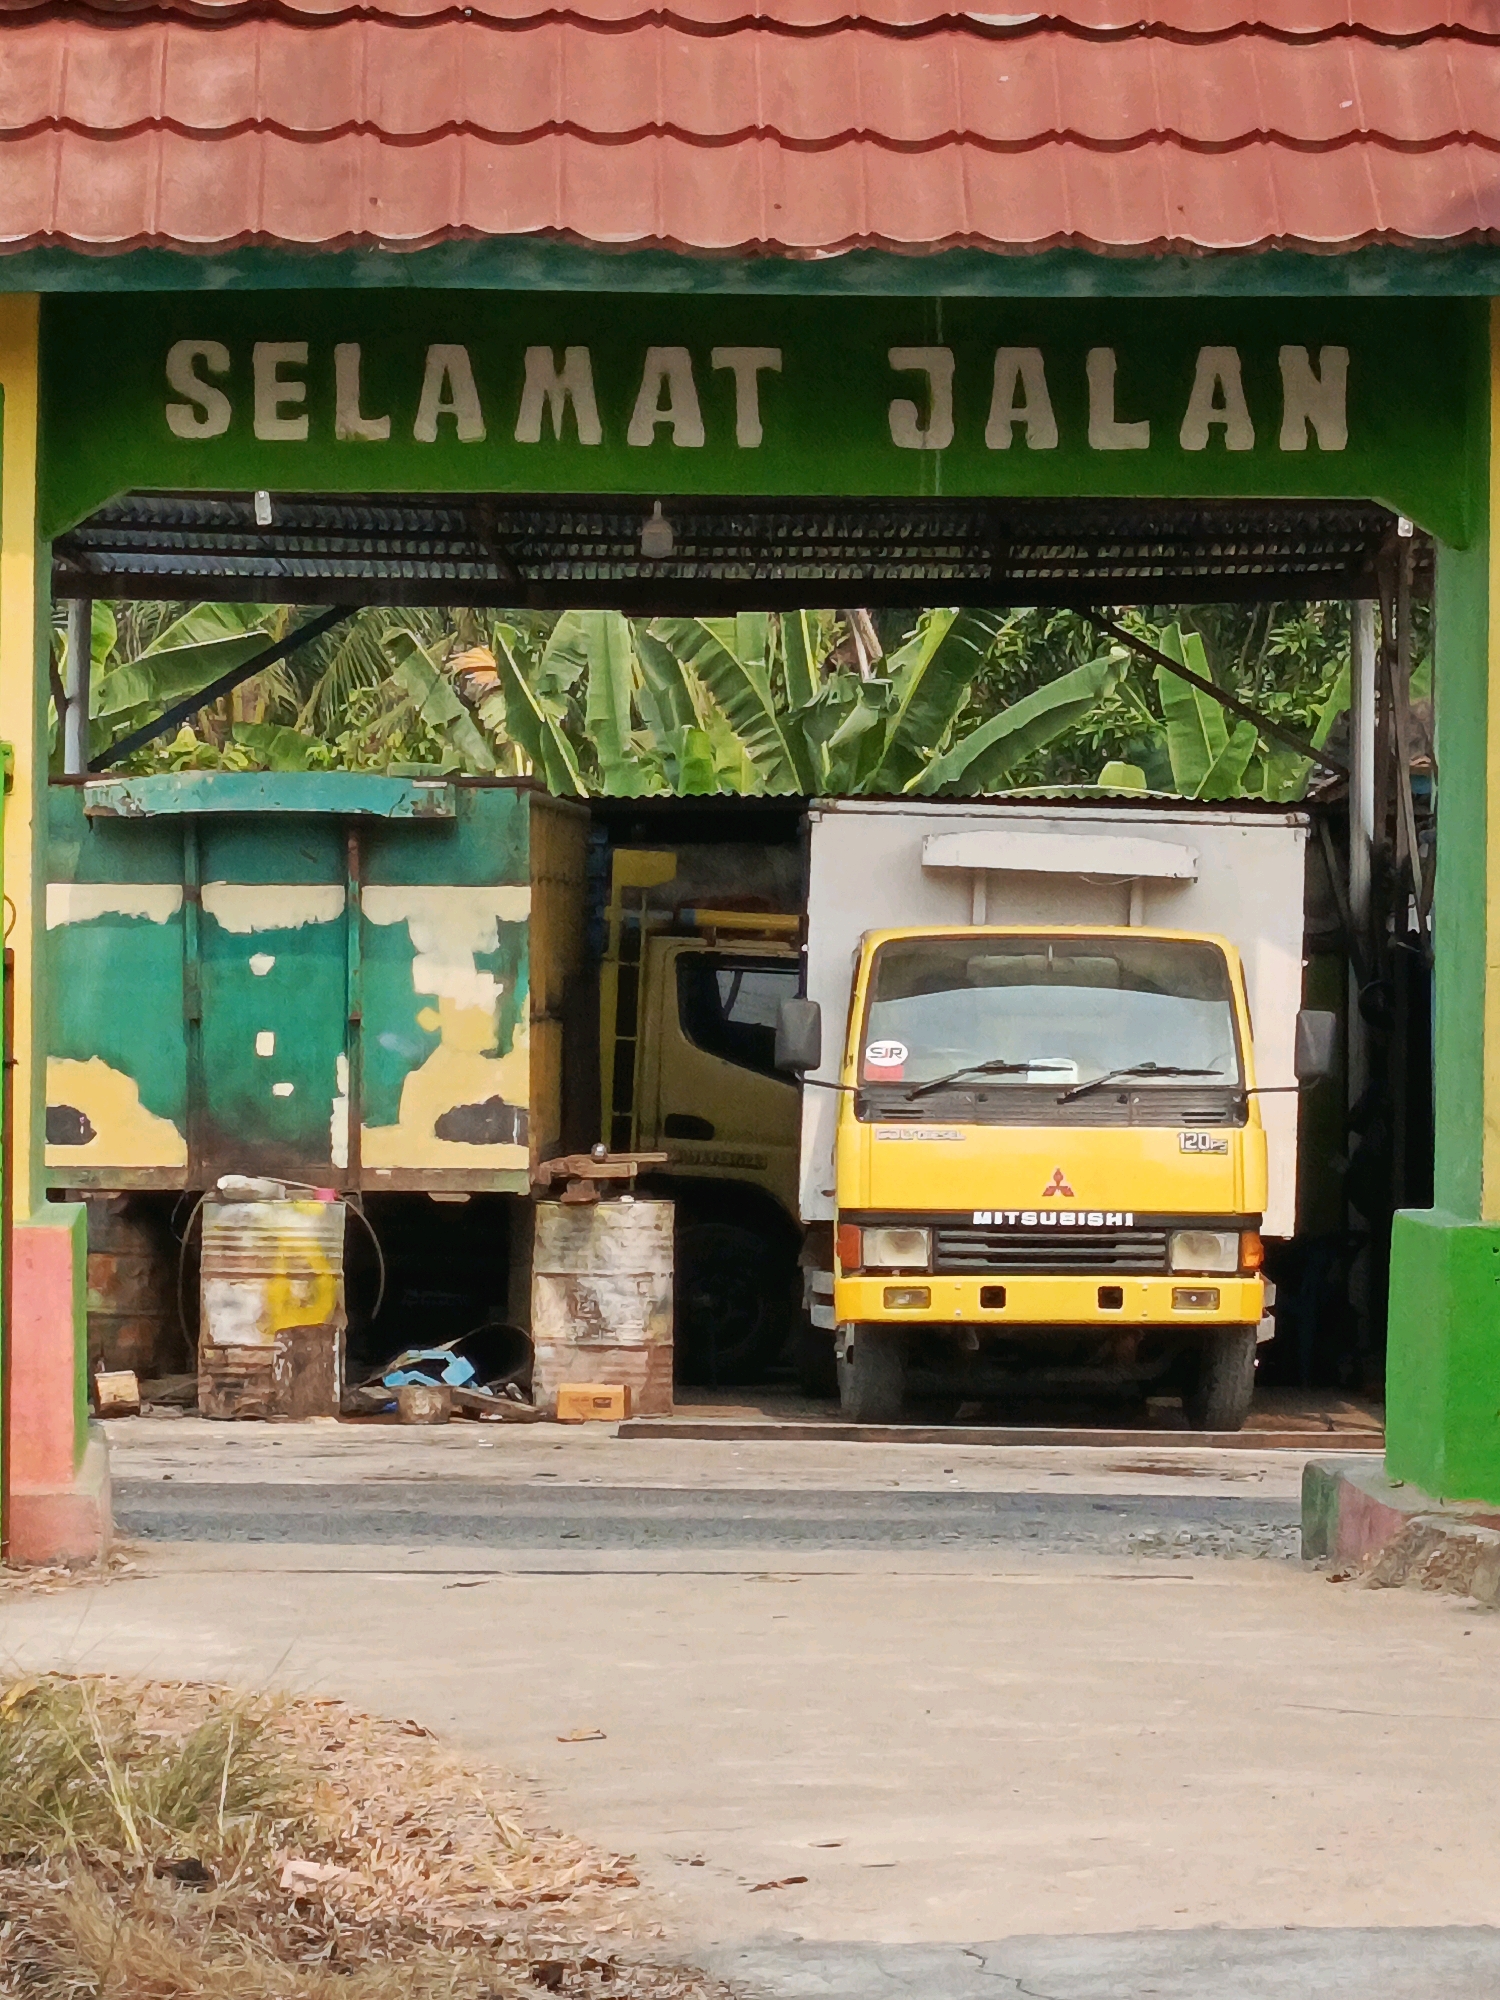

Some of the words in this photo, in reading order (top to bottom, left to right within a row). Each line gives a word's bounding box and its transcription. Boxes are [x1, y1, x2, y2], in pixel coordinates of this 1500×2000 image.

[165, 338, 783, 449] SELAMAT
[888, 344, 1349, 451] JALAN
[972, 1211, 1134, 1227] MITSUBISHI
